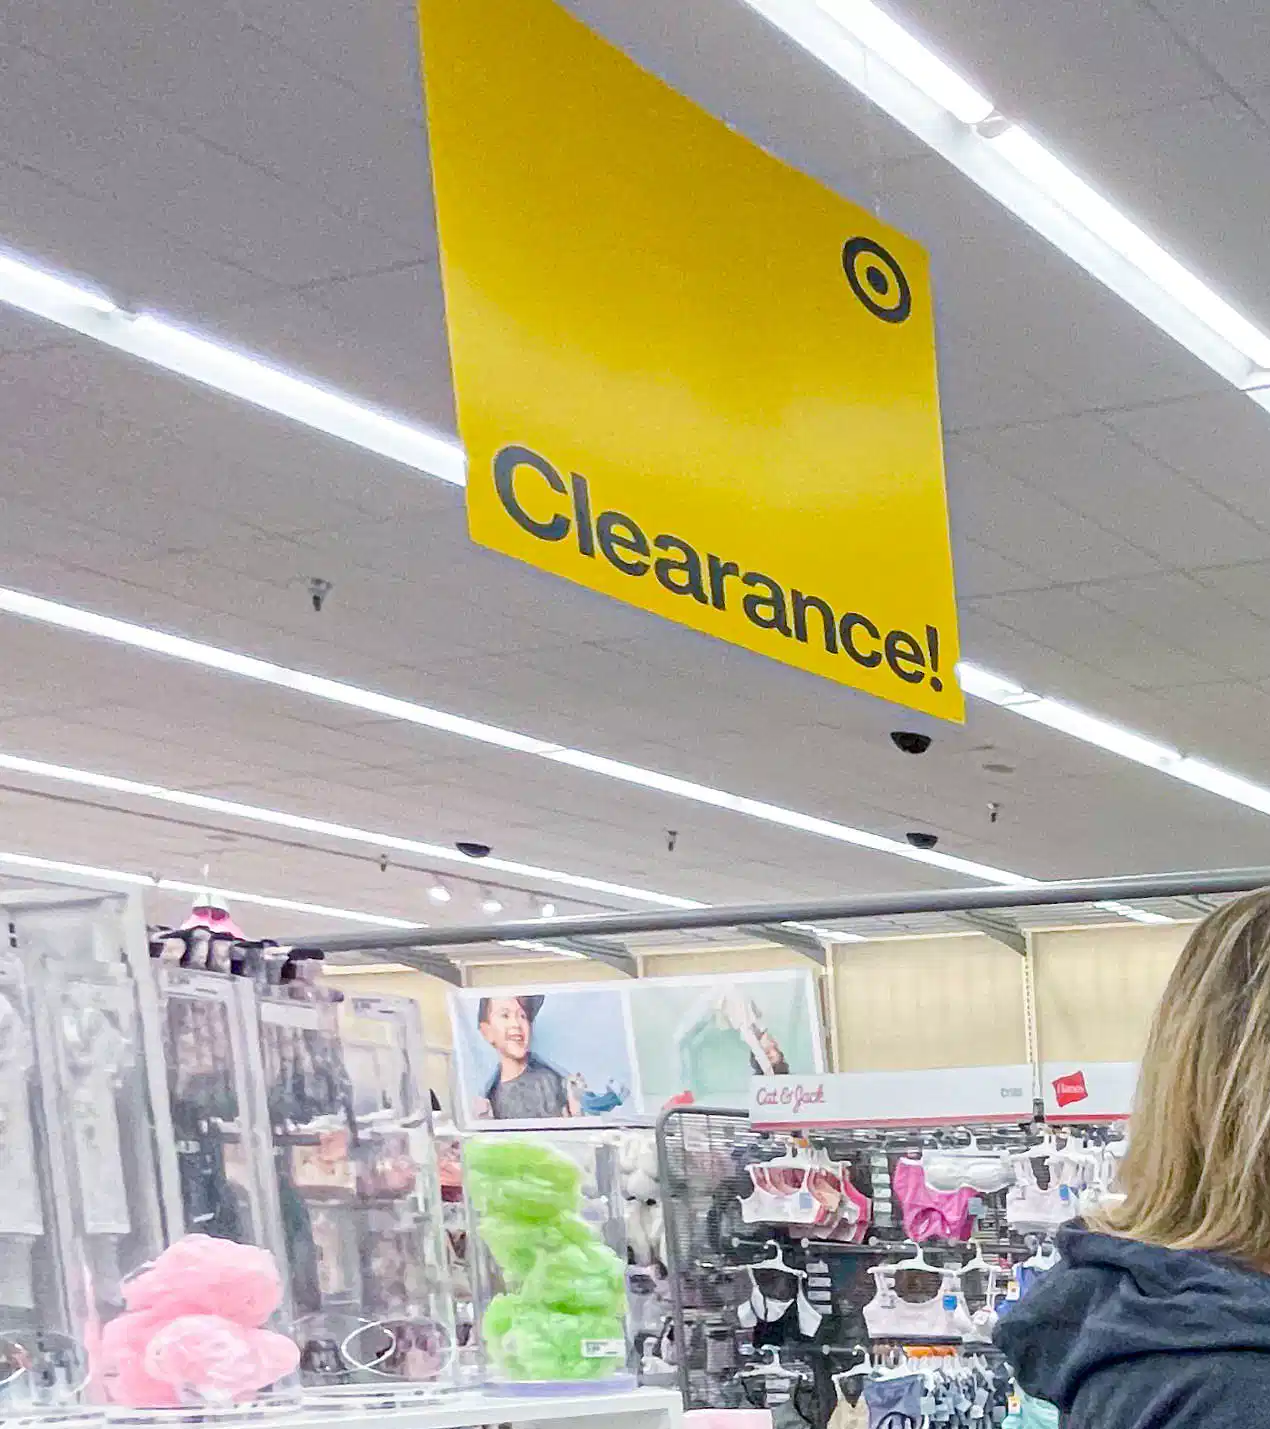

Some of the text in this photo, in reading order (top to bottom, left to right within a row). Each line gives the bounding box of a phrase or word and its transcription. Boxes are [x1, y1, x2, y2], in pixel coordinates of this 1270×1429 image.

[492, 444, 944, 692] Clearance!
[756, 1083, 827, 1113] Cat & Jack
